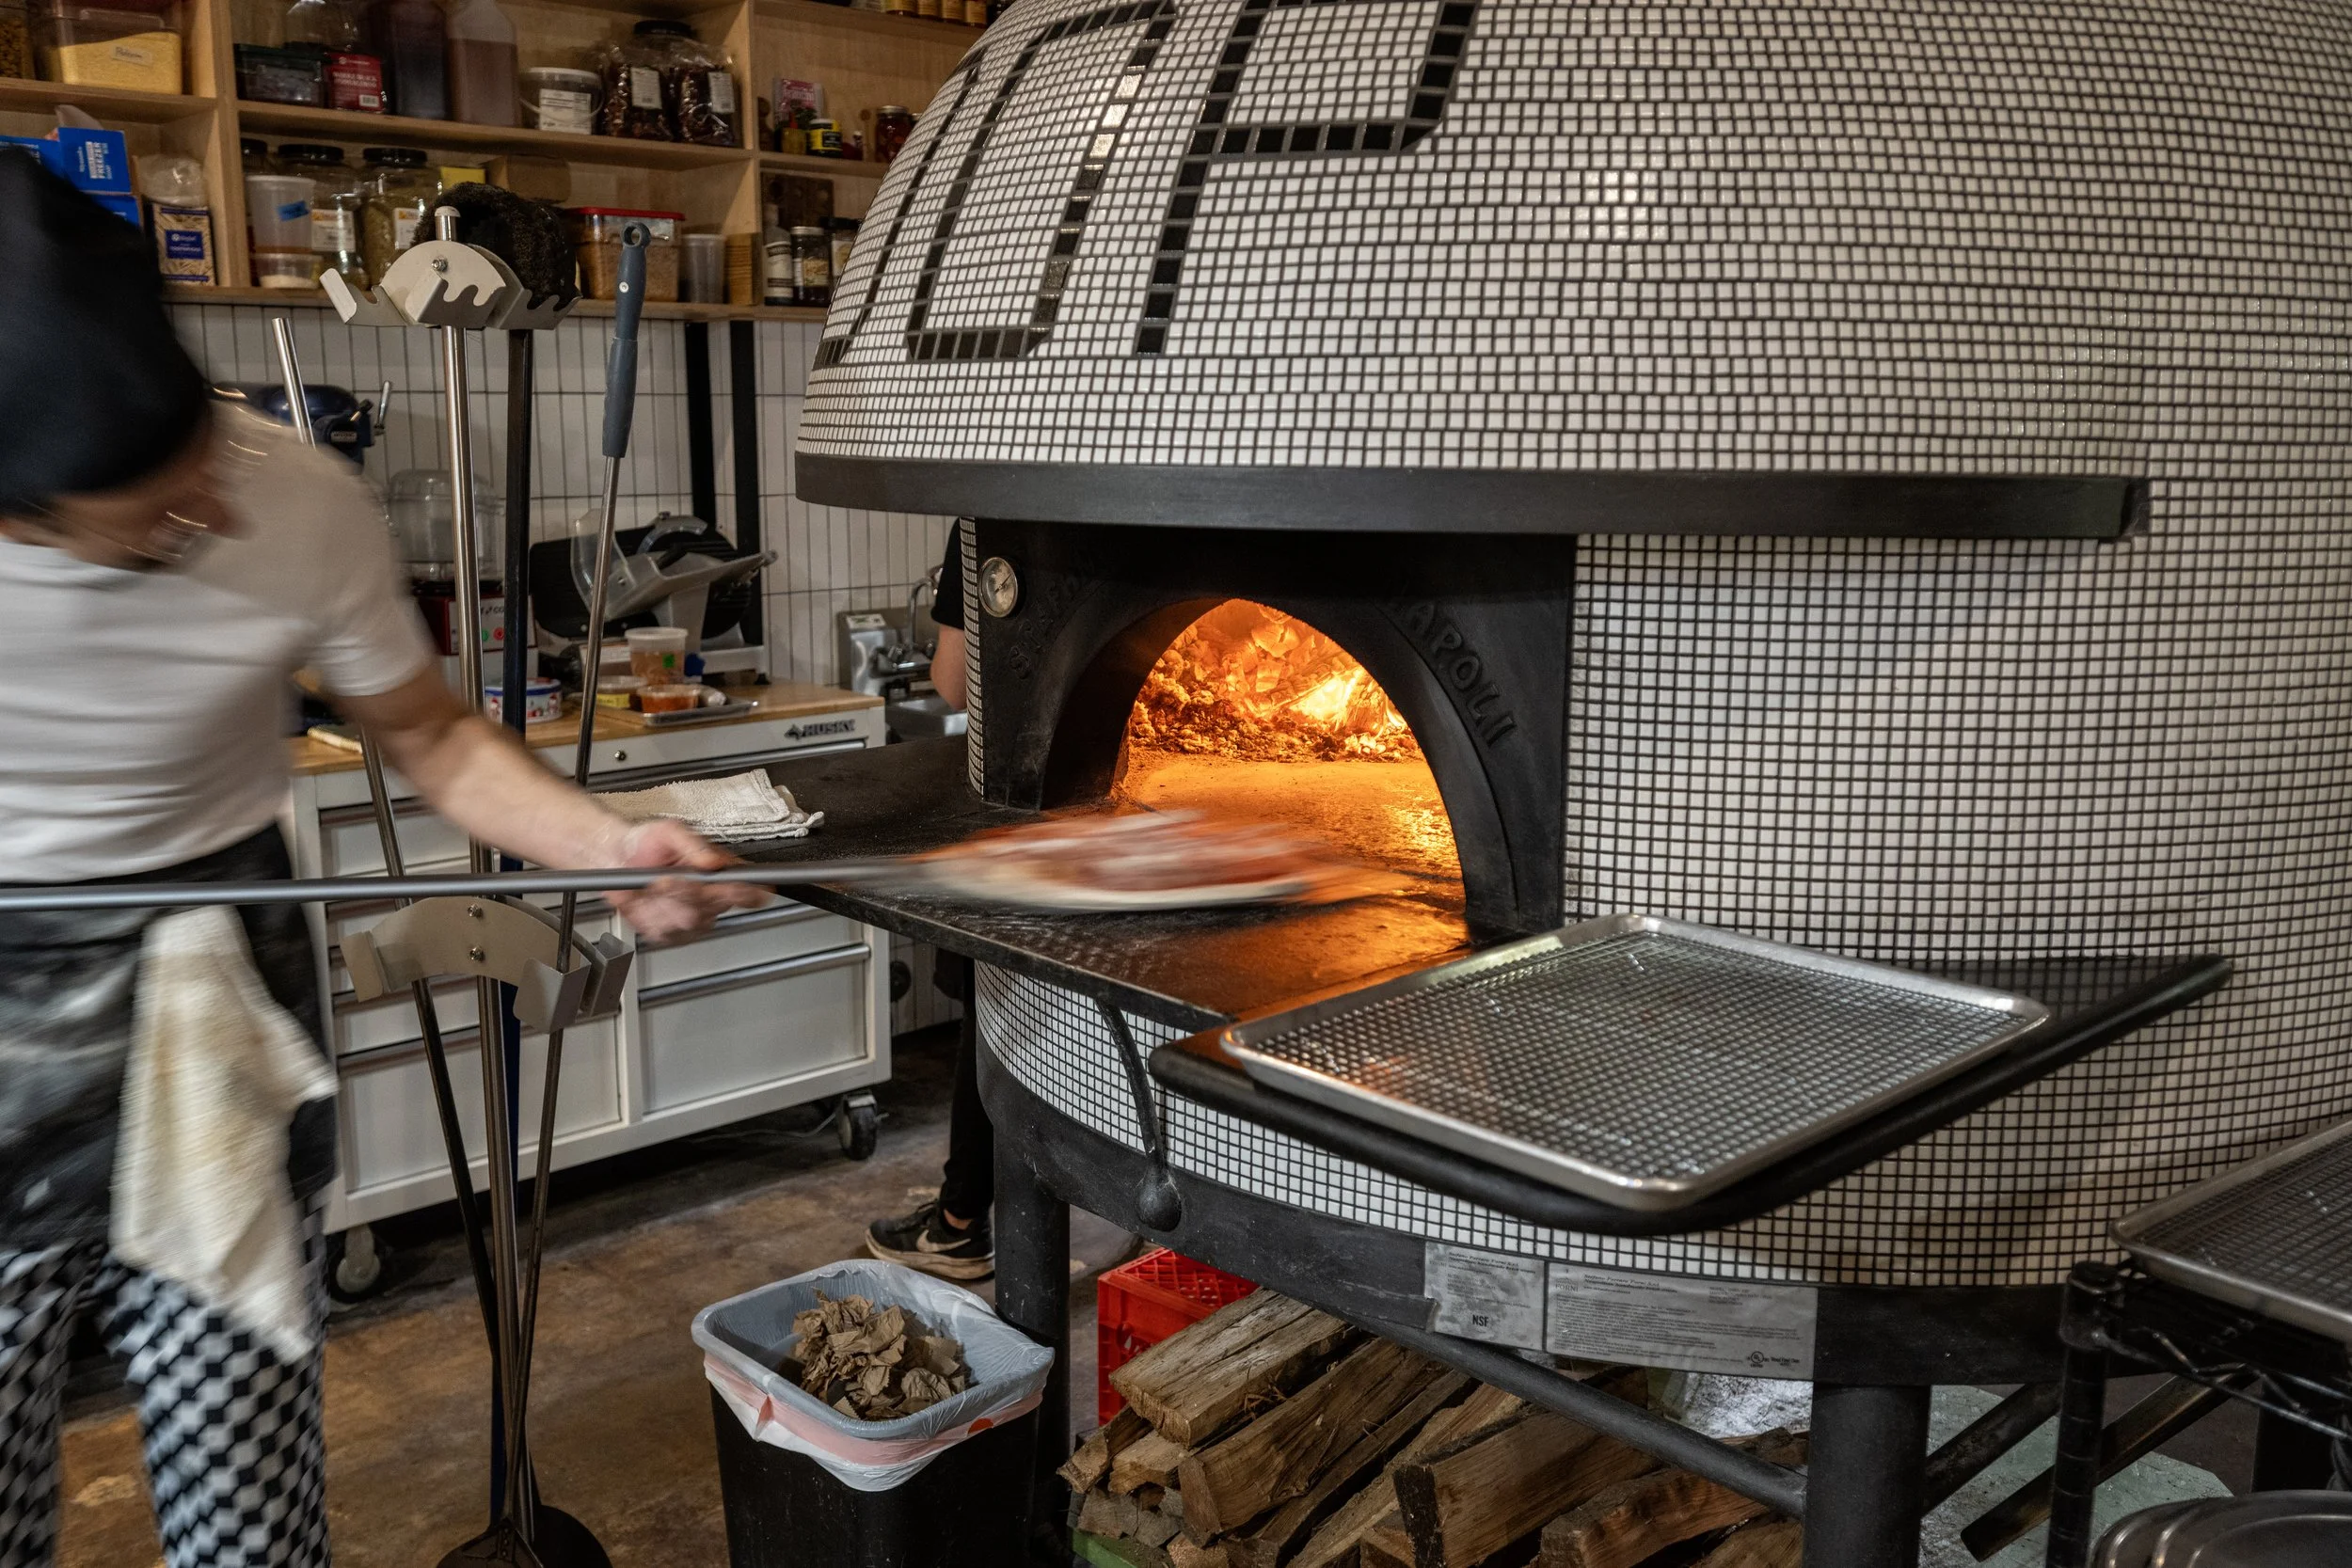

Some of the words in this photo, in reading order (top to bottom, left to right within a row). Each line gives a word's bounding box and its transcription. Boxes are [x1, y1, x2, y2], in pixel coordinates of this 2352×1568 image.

[1392, 581, 1518, 748] APOLI
[802, 719, 855, 736] HUSKY
[1472, 1314, 1488, 1327] NSF
